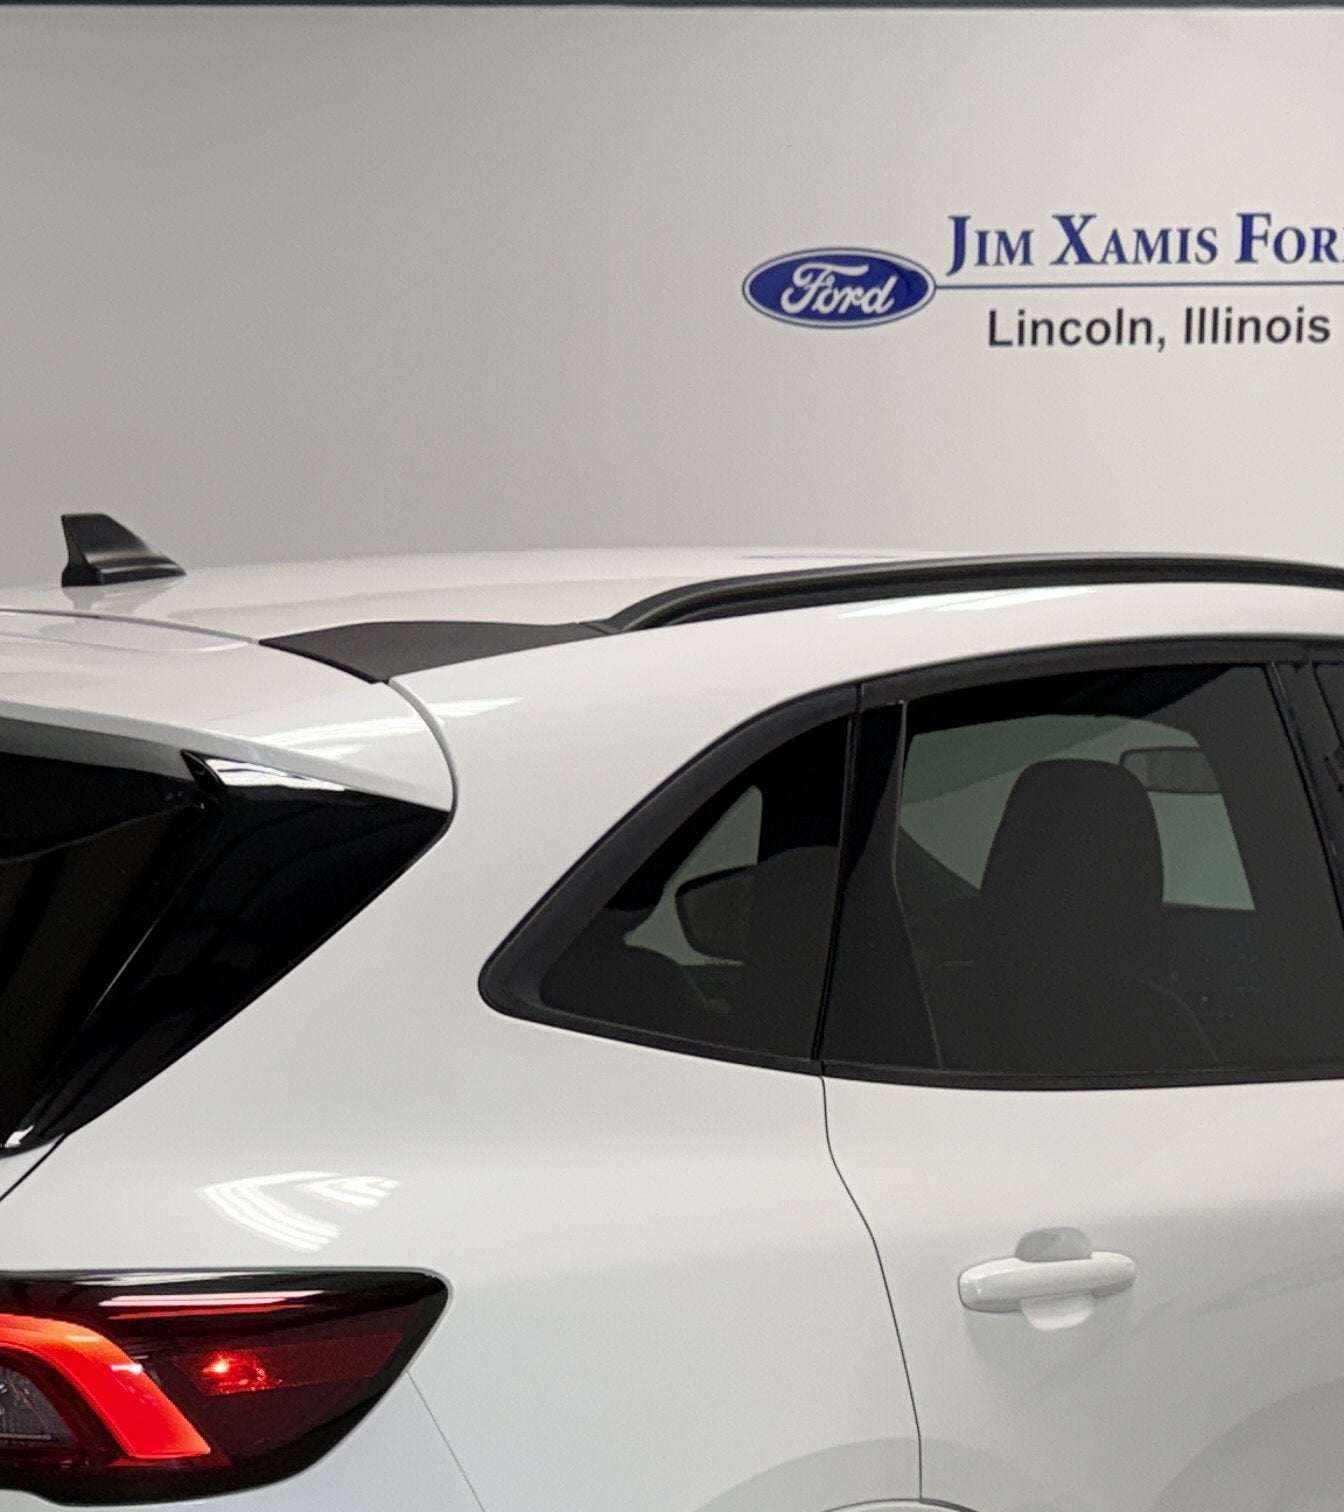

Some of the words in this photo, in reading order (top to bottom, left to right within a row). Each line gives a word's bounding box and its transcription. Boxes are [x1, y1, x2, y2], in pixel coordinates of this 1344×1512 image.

[946, 214, 1034, 277] JIM
[1050, 214, 1219, 265] XAMIS
[779, 260, 899, 316] Ford
[988, 308, 1166, 352] Lincoln,
[1184, 306, 1331, 344] Illinois
